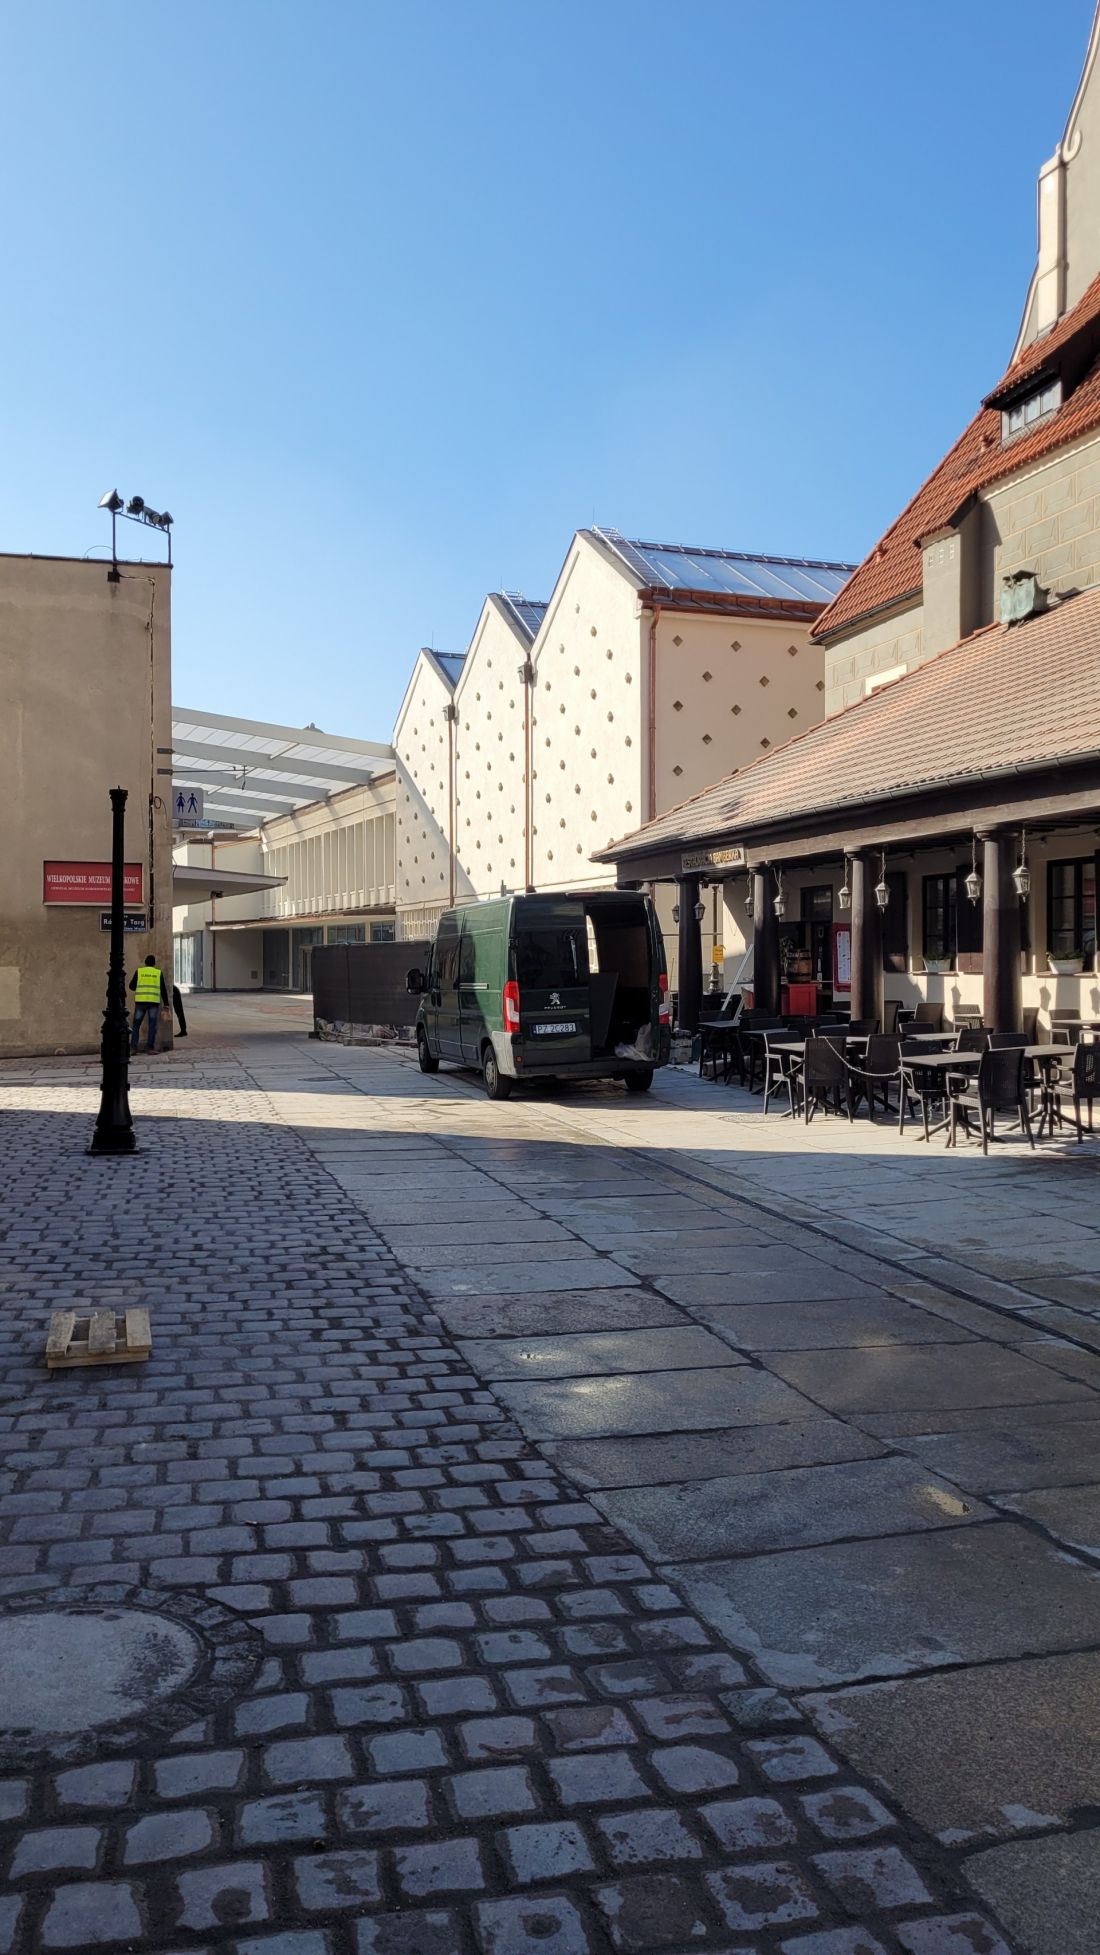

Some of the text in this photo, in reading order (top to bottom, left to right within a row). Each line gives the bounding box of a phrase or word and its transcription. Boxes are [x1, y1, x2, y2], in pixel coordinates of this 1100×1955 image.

[46, 874, 87, 884] WIELKOPOLSKIE
[88, 875, 111, 884] MUZEUM
[130, 918, 145, 926] Targ
